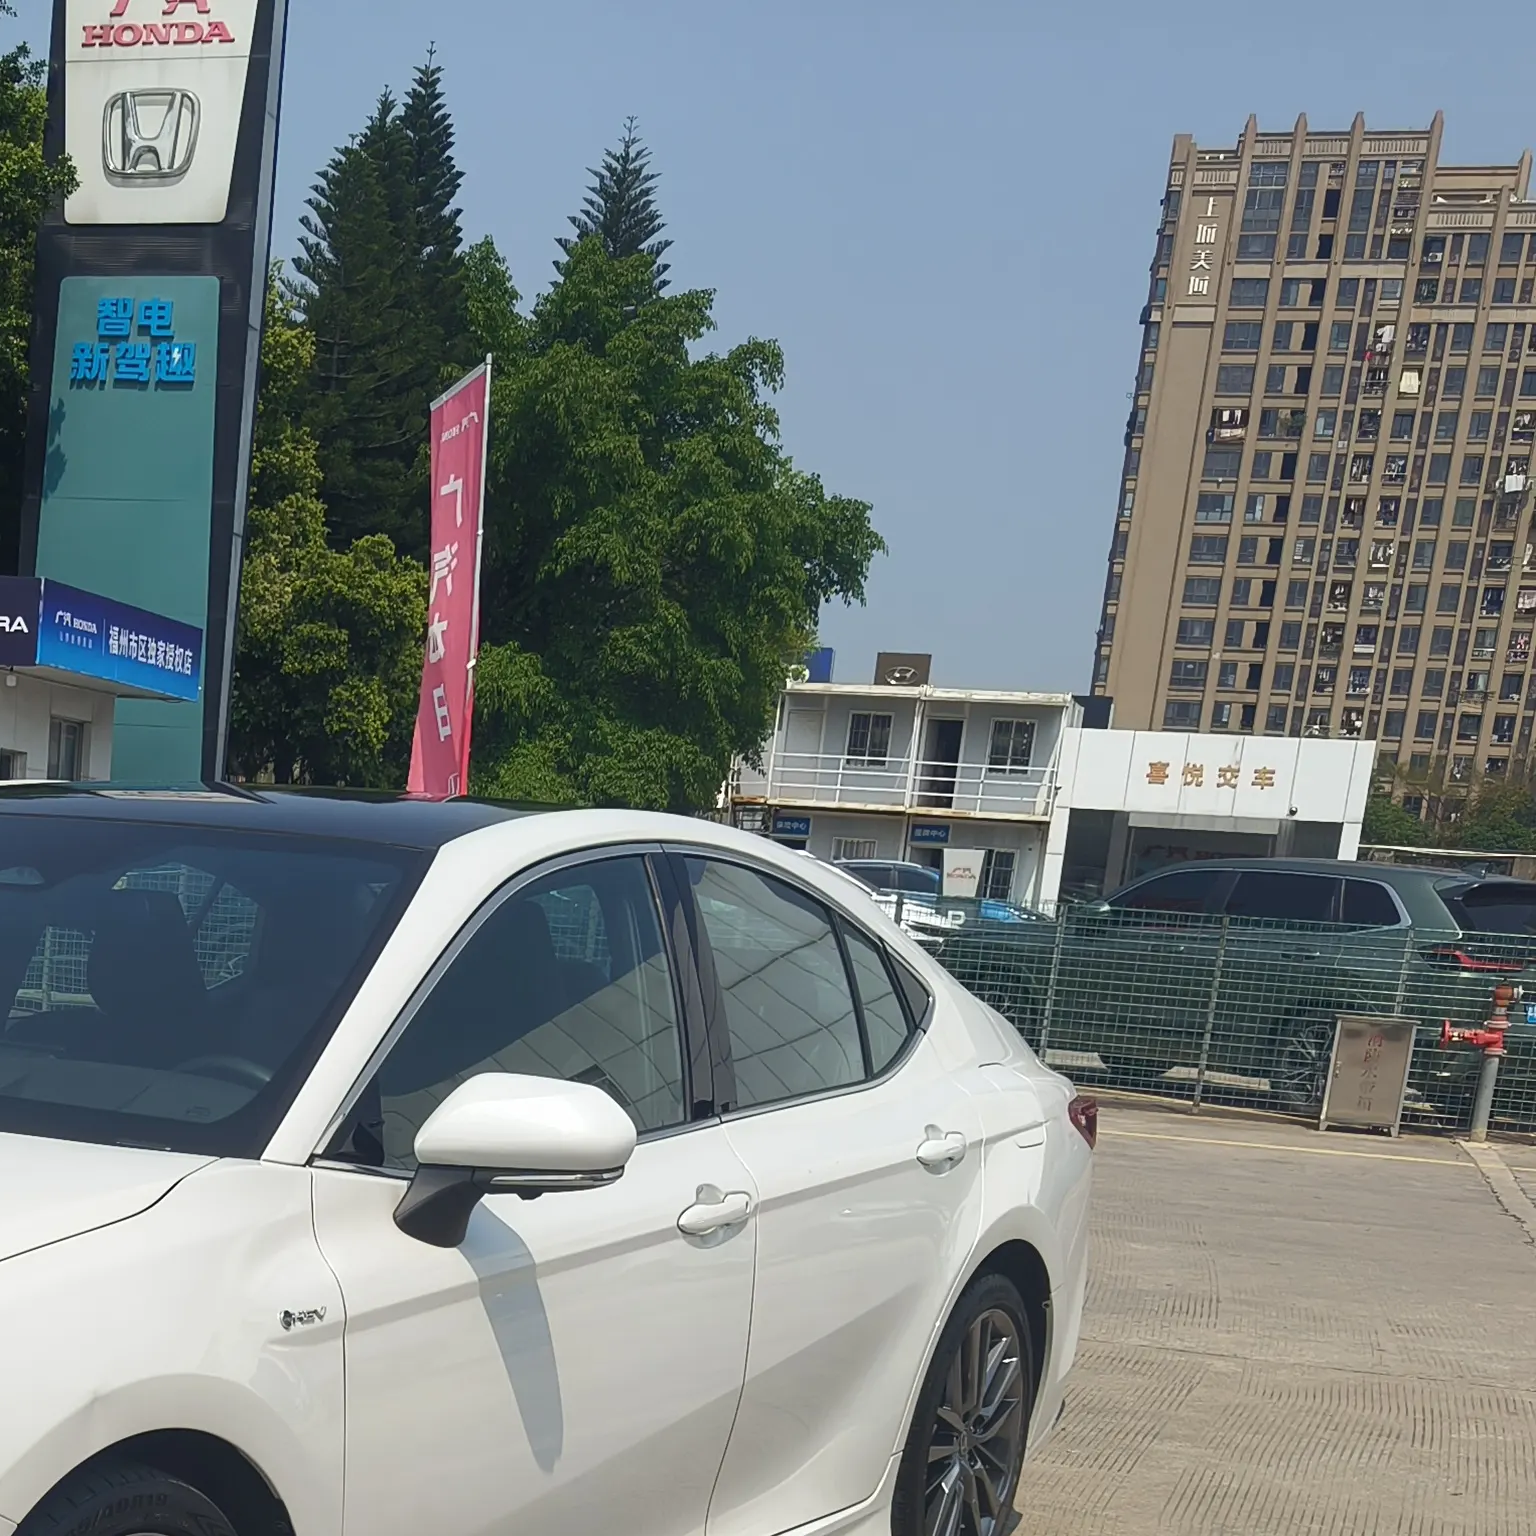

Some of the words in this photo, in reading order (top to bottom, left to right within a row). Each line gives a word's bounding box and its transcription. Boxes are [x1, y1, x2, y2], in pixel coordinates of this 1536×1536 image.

[81, 21, 235, 48] HONDA
[96, 297, 175, 338] 智电
[70, 342, 197, 383] 新驾趣
[73, 618, 97, 634] HONDA
[108, 625, 193, 676] 福州市区独家授权店
[1146, 761, 1276, 790] 喜悦交车
